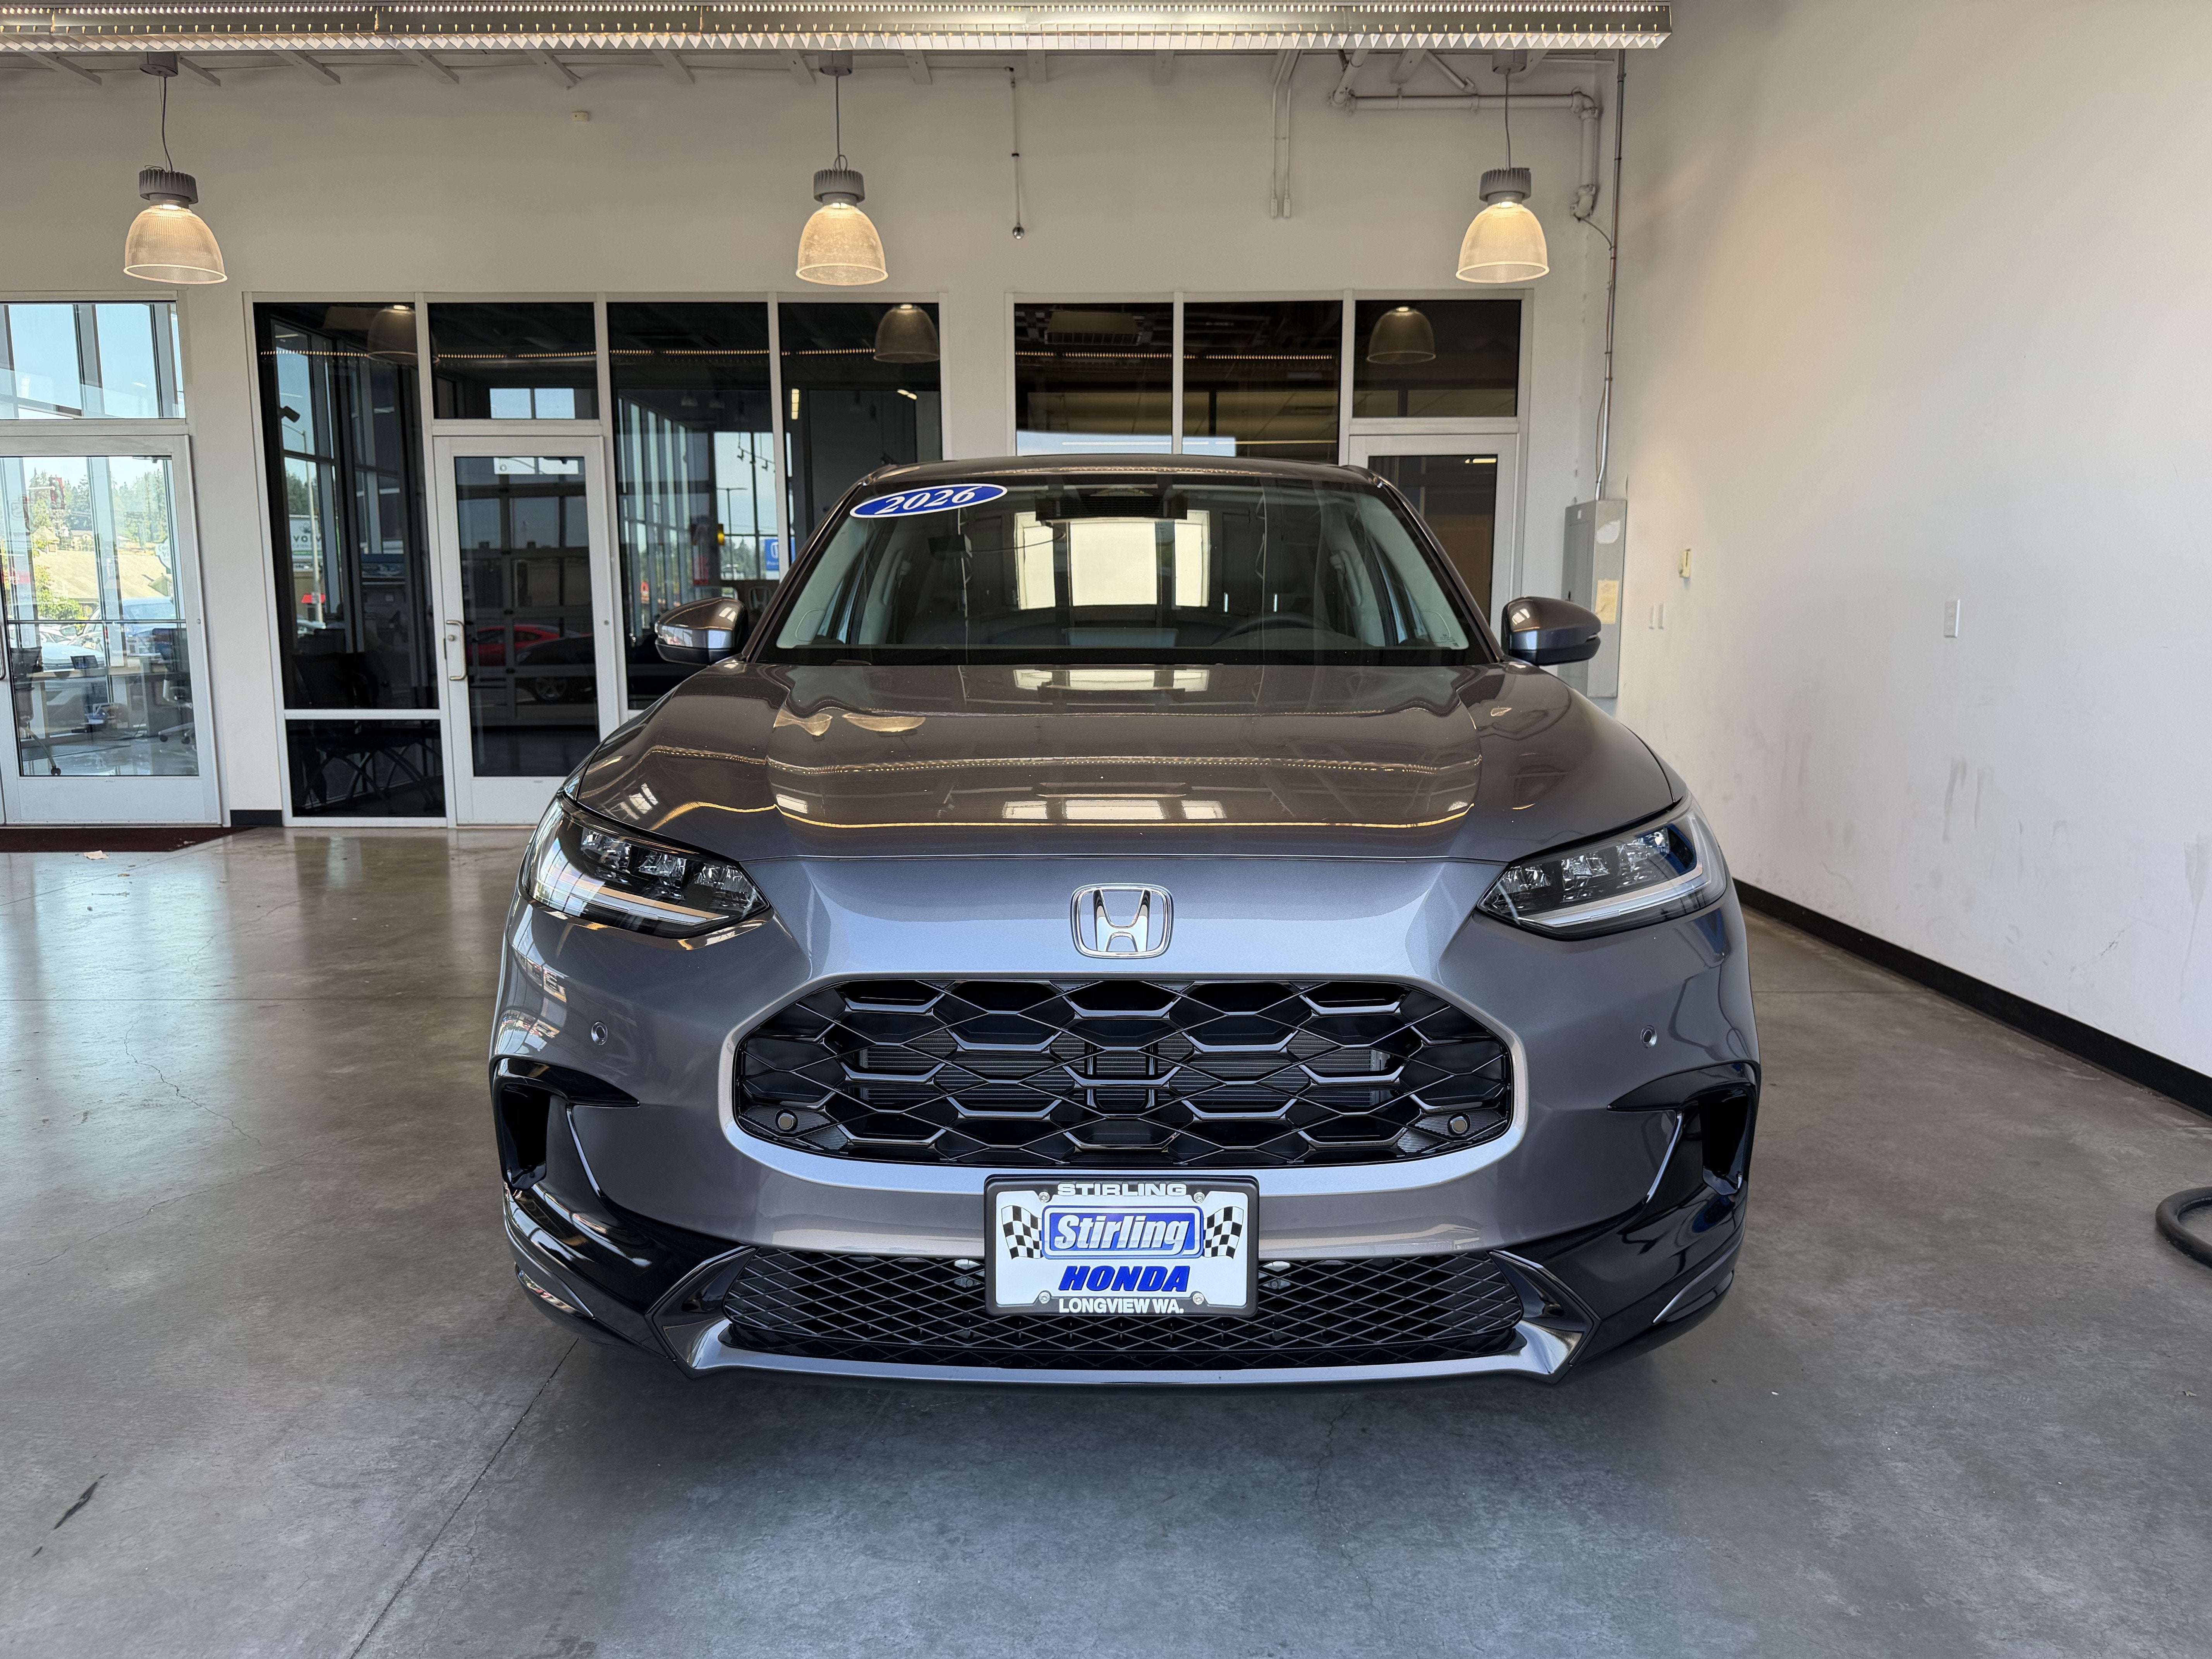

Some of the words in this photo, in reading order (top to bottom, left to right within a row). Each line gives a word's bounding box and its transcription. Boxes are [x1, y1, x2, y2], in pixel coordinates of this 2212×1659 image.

[874, 486, 982, 515] 2026
[1057, 1183, 1187, 1197] STIRLING
[1054, 1214, 1190, 1254] Stirling
[1058, 1266, 1190, 1292] HONDA
[1059, 1298, 1151, 1314] LONGVIEW
[1152, 1298, 1184, 1314] WA.
